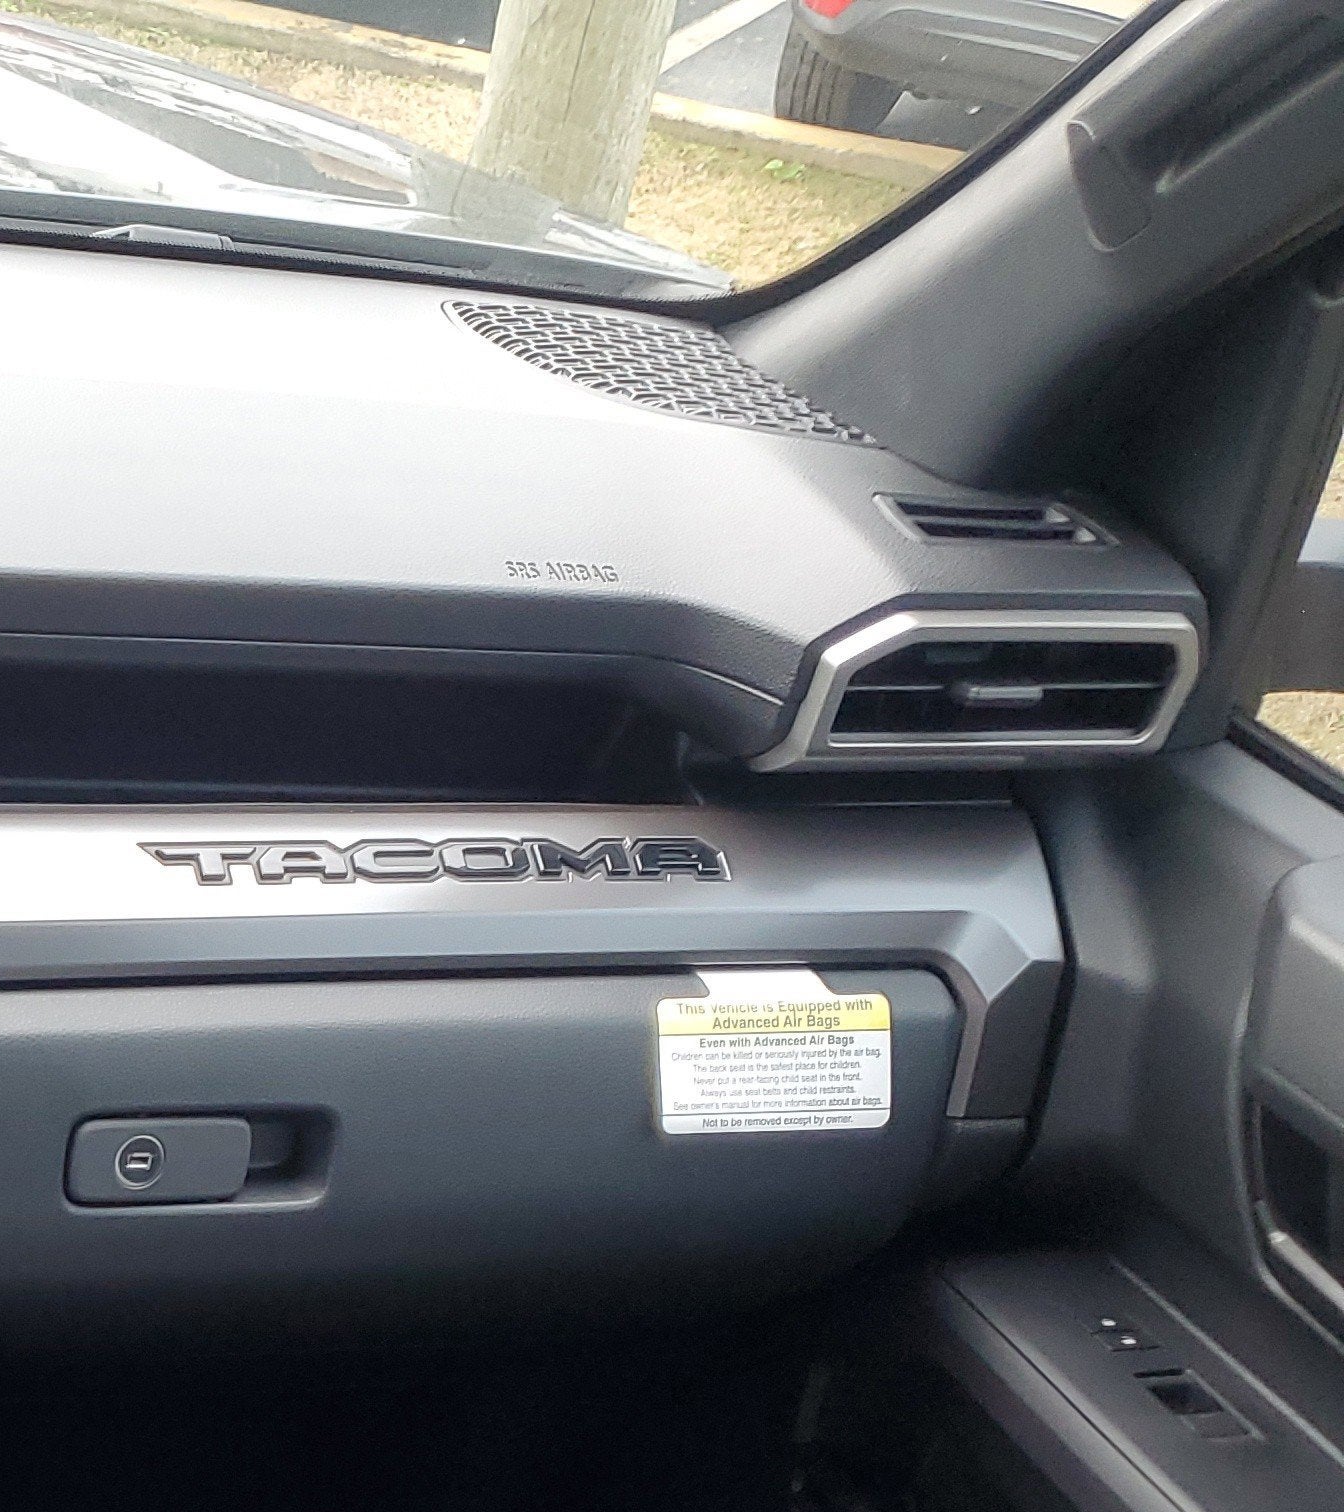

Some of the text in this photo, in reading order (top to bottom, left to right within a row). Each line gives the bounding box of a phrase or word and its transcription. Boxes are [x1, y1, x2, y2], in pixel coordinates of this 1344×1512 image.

[505, 560, 619, 582] SRS AIRBAG
[136, 837, 732, 886] TACOMA
[677, 1003, 706, 1015] This
[778, 1000, 842, 1016] Equipped
[844, 999, 873, 1012] with
[712, 1014, 840, 1030] Advanced Air Bags
[699, 1034, 854, 1049] Even with Advanced Air Bags
[733, 1051, 753, 1060] killed
[829, 1048, 837, 1059] by
[840, 1048, 852, 1057] the
[694, 1064, 707, 1072] The
[709, 1063, 727, 1072] back
[756, 1063, 768, 1071] the
[770, 1062, 793, 1071] safest
[795, 1061, 815, 1071] place
[818, 1060, 827, 1070] for
[694, 1077, 715, 1085] Never
[781, 1074, 799, 1083] child
[801, 1074, 817, 1082] seat
[828, 1073, 840, 1082] the
[784, 1086, 797, 1095] and
[800, 1086, 817, 1095] child
[673, 1101, 688, 1111] See
[721, 1100, 749, 1109] manual
[752, 1099, 761, 1108] for
[764, 1099, 782, 1108] more
[784, 1098, 827, 1108] information
[828, 1097, 849, 1107] about
[852, 1097, 861, 1106] air
[702, 1118, 718, 1128] Not
[721, 1118, 729, 1127] to
[731, 1117, 742, 1127] be
[744, 1116, 782, 1126] removed
[784, 1115, 812, 1126] except
[814, 1114, 824, 1126] by
